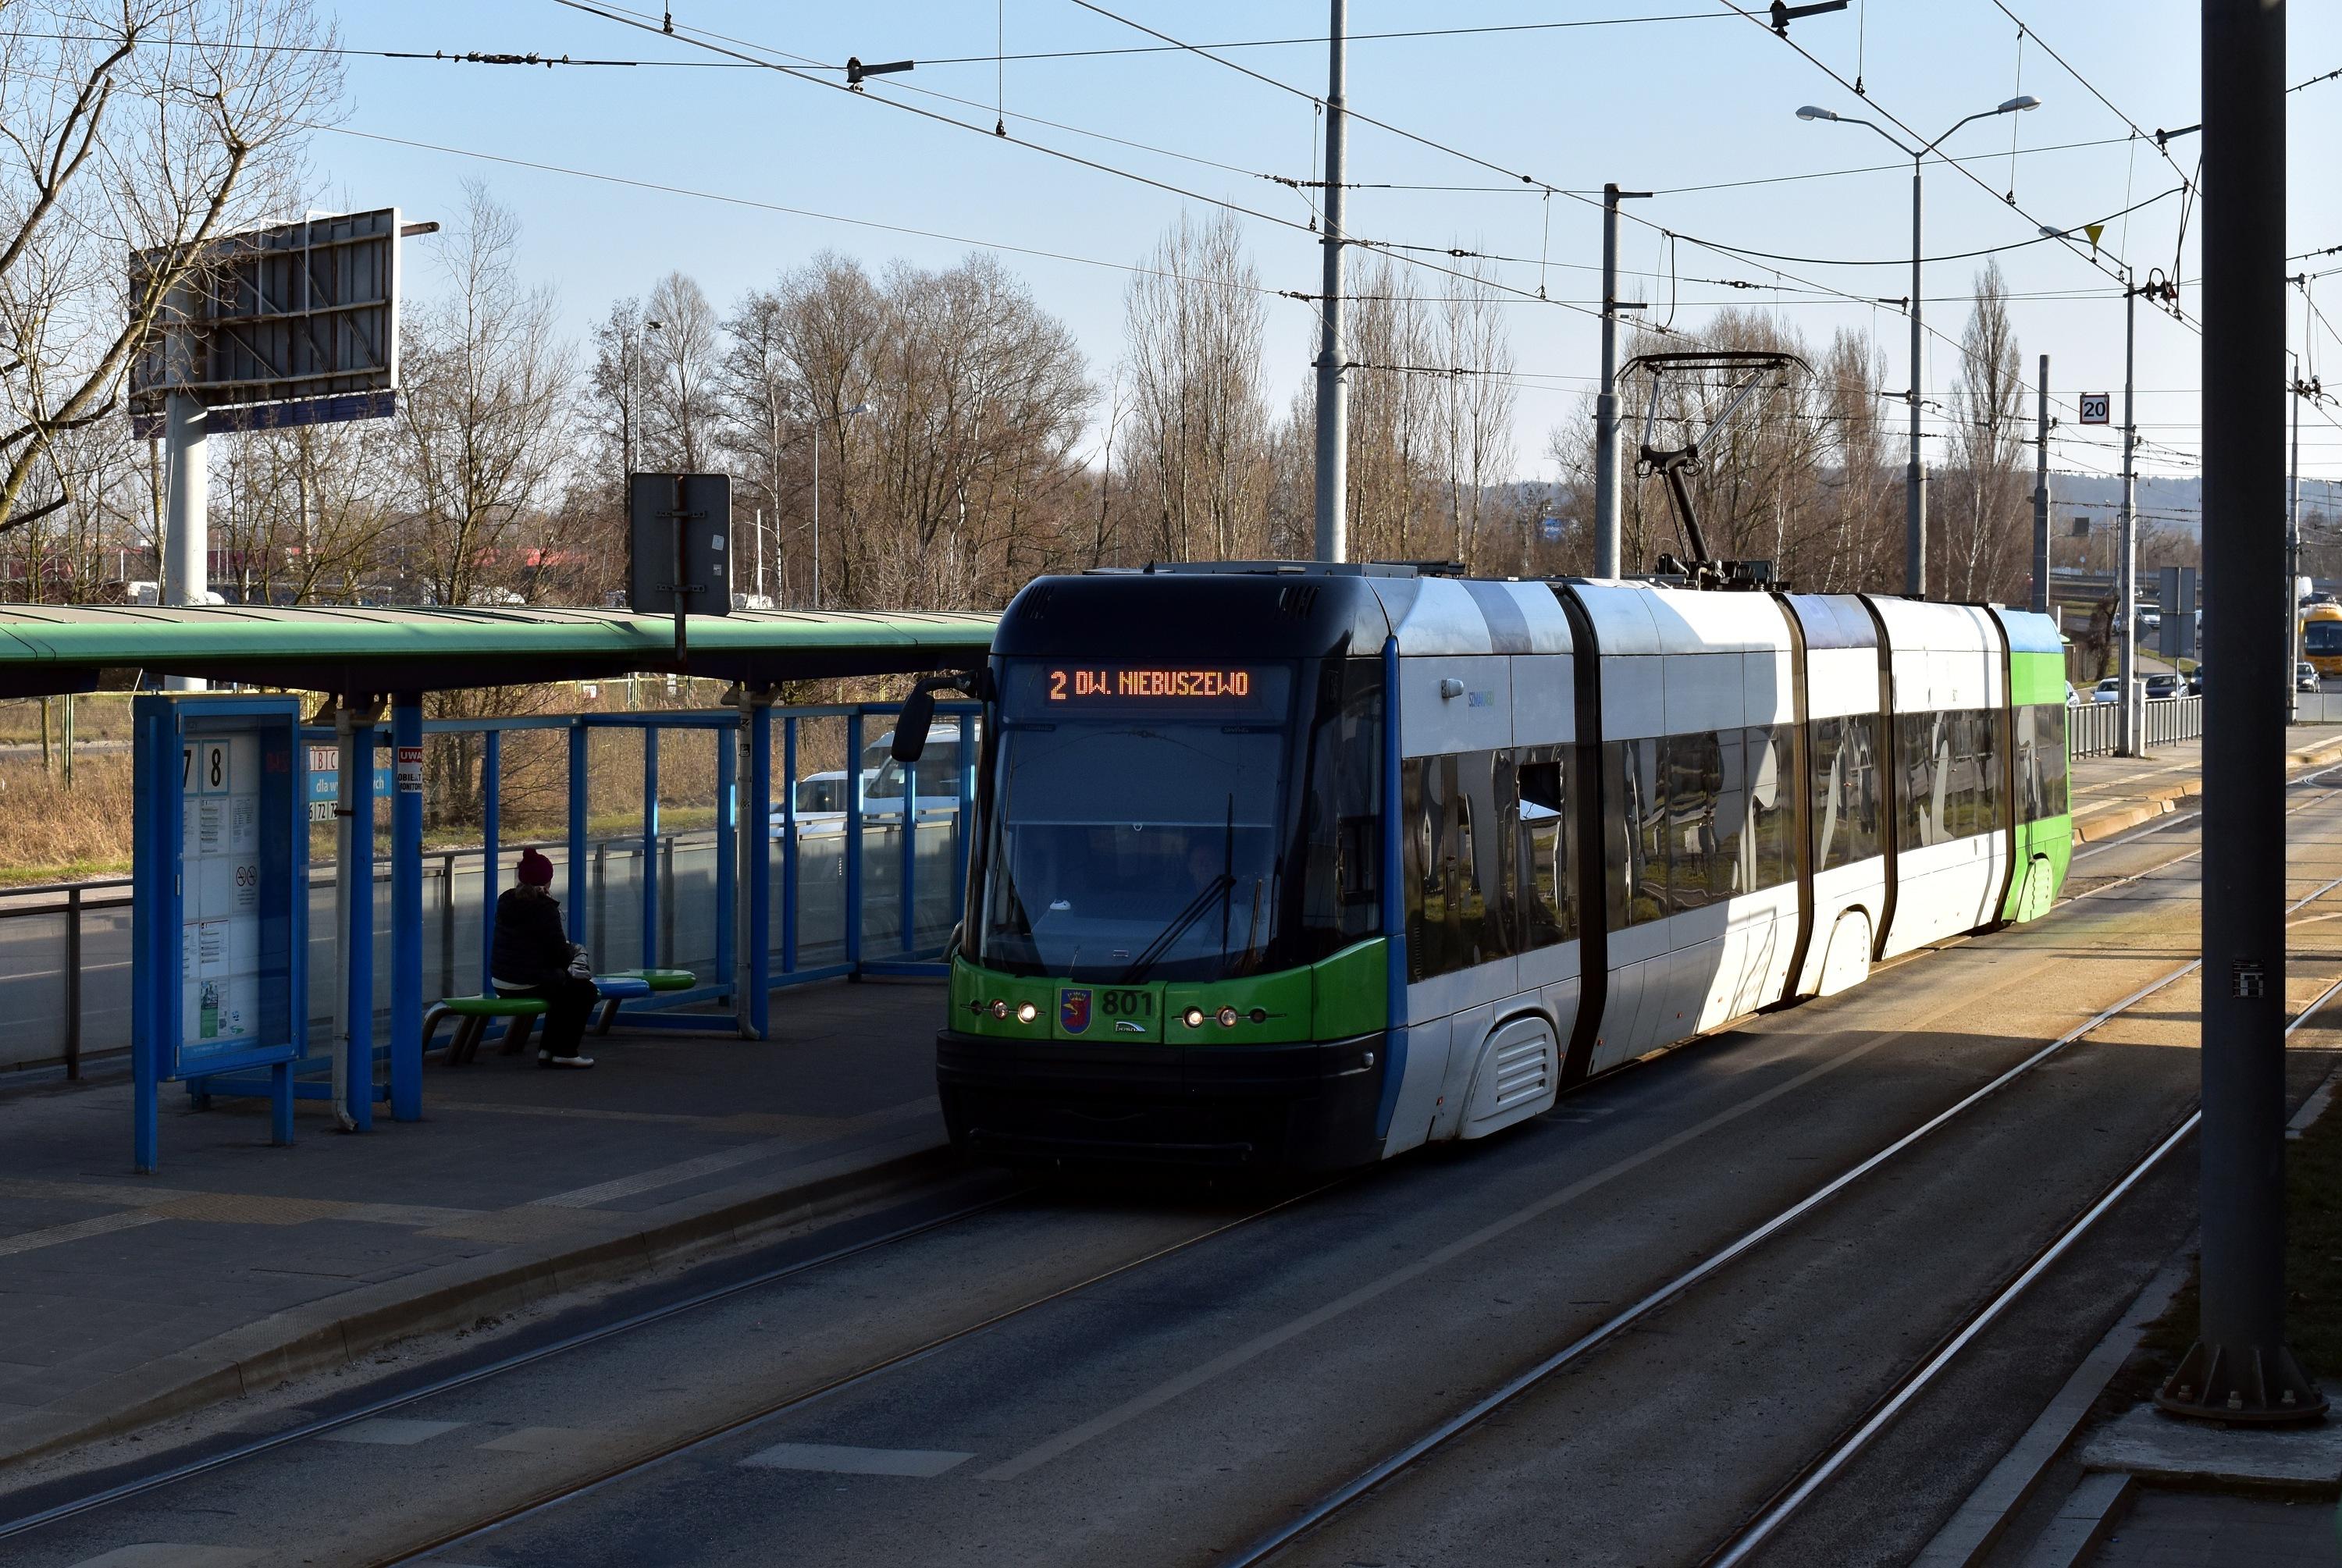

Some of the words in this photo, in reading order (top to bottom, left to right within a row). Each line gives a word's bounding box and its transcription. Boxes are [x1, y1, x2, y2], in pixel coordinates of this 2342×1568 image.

[2084, 402, 2105, 418] 20
[1050, 670, 1067, 700] 2
[1075, 670, 1112, 695] DW.
[1118, 670, 1248, 695] NIEBUSZEWO
[318, 752, 323, 769] B
[331, 752, 336, 769] C
[400, 751, 422, 759] UWA
[183, 749, 192, 788] 7
[211, 748, 222, 788] 8
[316, 778, 329, 793] dla
[318, 803, 326, 819] 72
[1102, 990, 1151, 1016] 801
